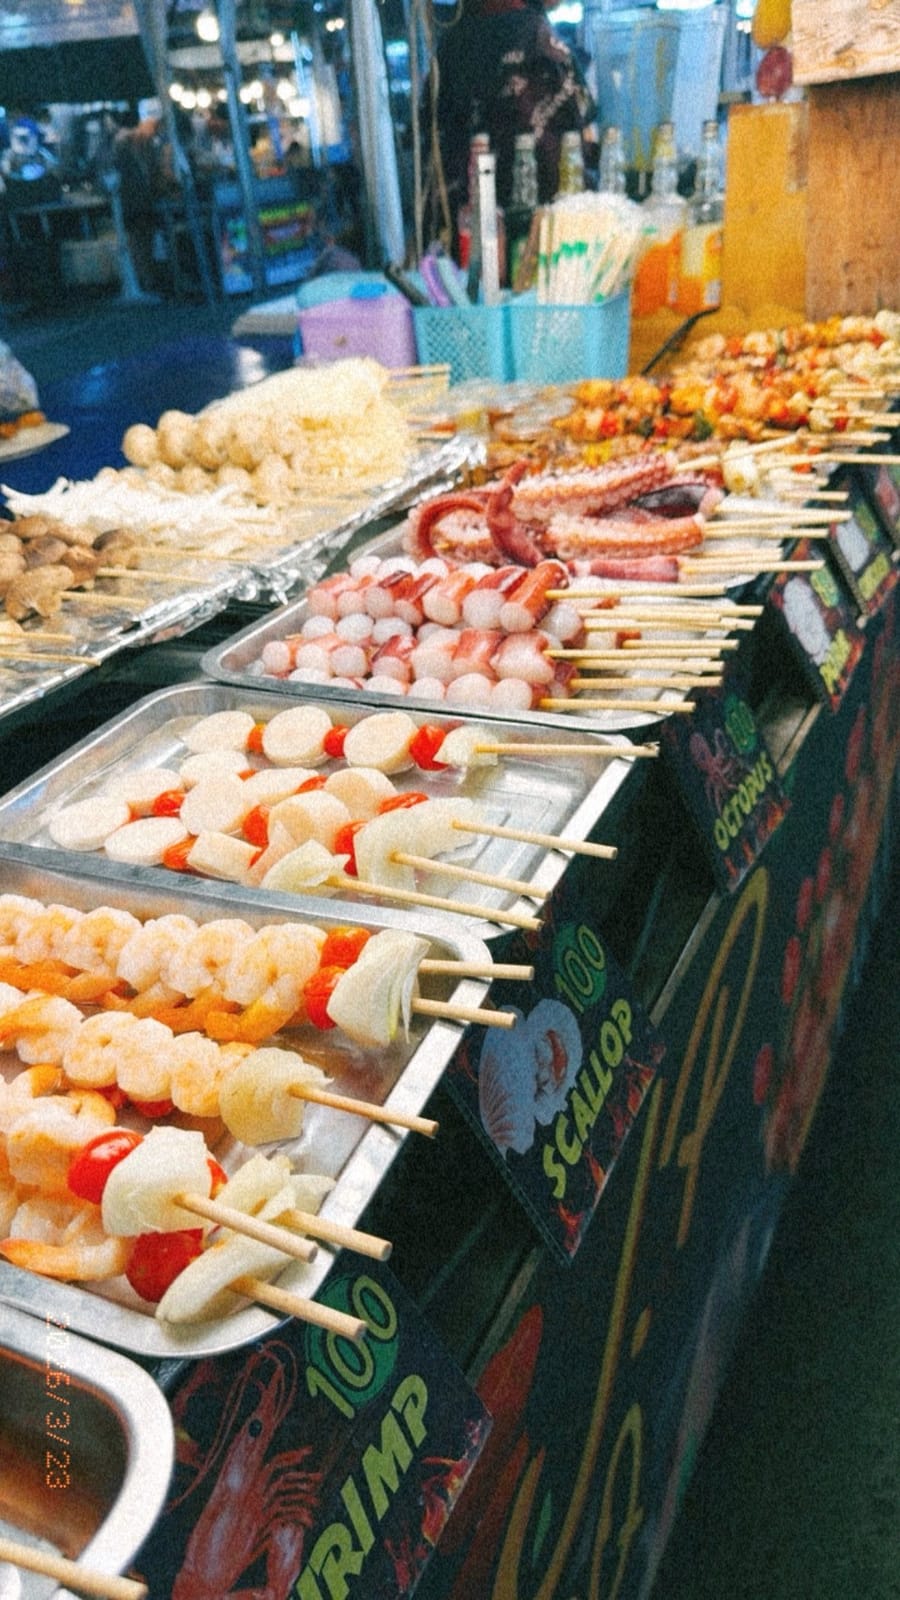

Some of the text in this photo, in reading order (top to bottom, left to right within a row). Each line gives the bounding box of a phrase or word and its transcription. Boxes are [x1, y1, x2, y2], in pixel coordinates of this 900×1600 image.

[714, 751, 773, 851] OCTOPUS
[555, 924, 604, 1013] 100
[543, 998, 633, 1199] SCALLOP
[306, 1275, 397, 1419] 100
